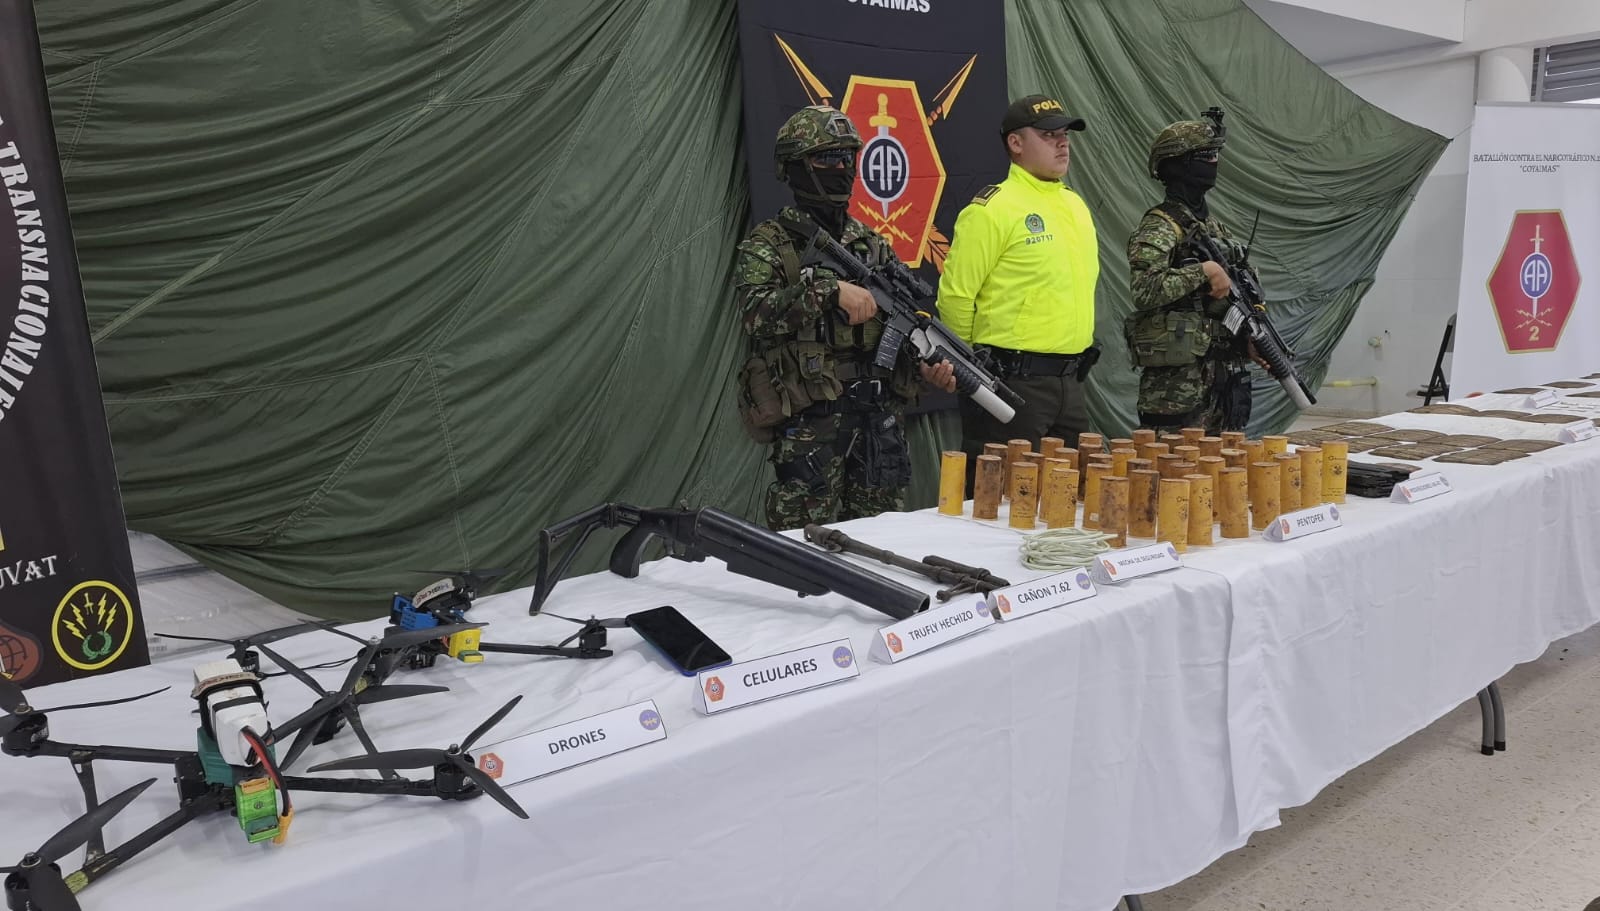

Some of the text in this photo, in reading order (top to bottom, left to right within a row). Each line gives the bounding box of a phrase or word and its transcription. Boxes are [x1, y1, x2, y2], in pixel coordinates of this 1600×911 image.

[869, 145, 902, 191] AA
[1509, 154, 1535, 162] CONTRA
[1524, 259, 1548, 292] AA
[1528, 325, 1540, 342] 2
[1017, 581, 1072, 604] CAÑON 7.62
[908, 610, 974, 641] TRUFLY HECHIZO
[742, 658, 818, 688] CELULARES
[548, 728, 607, 755] DRONES
